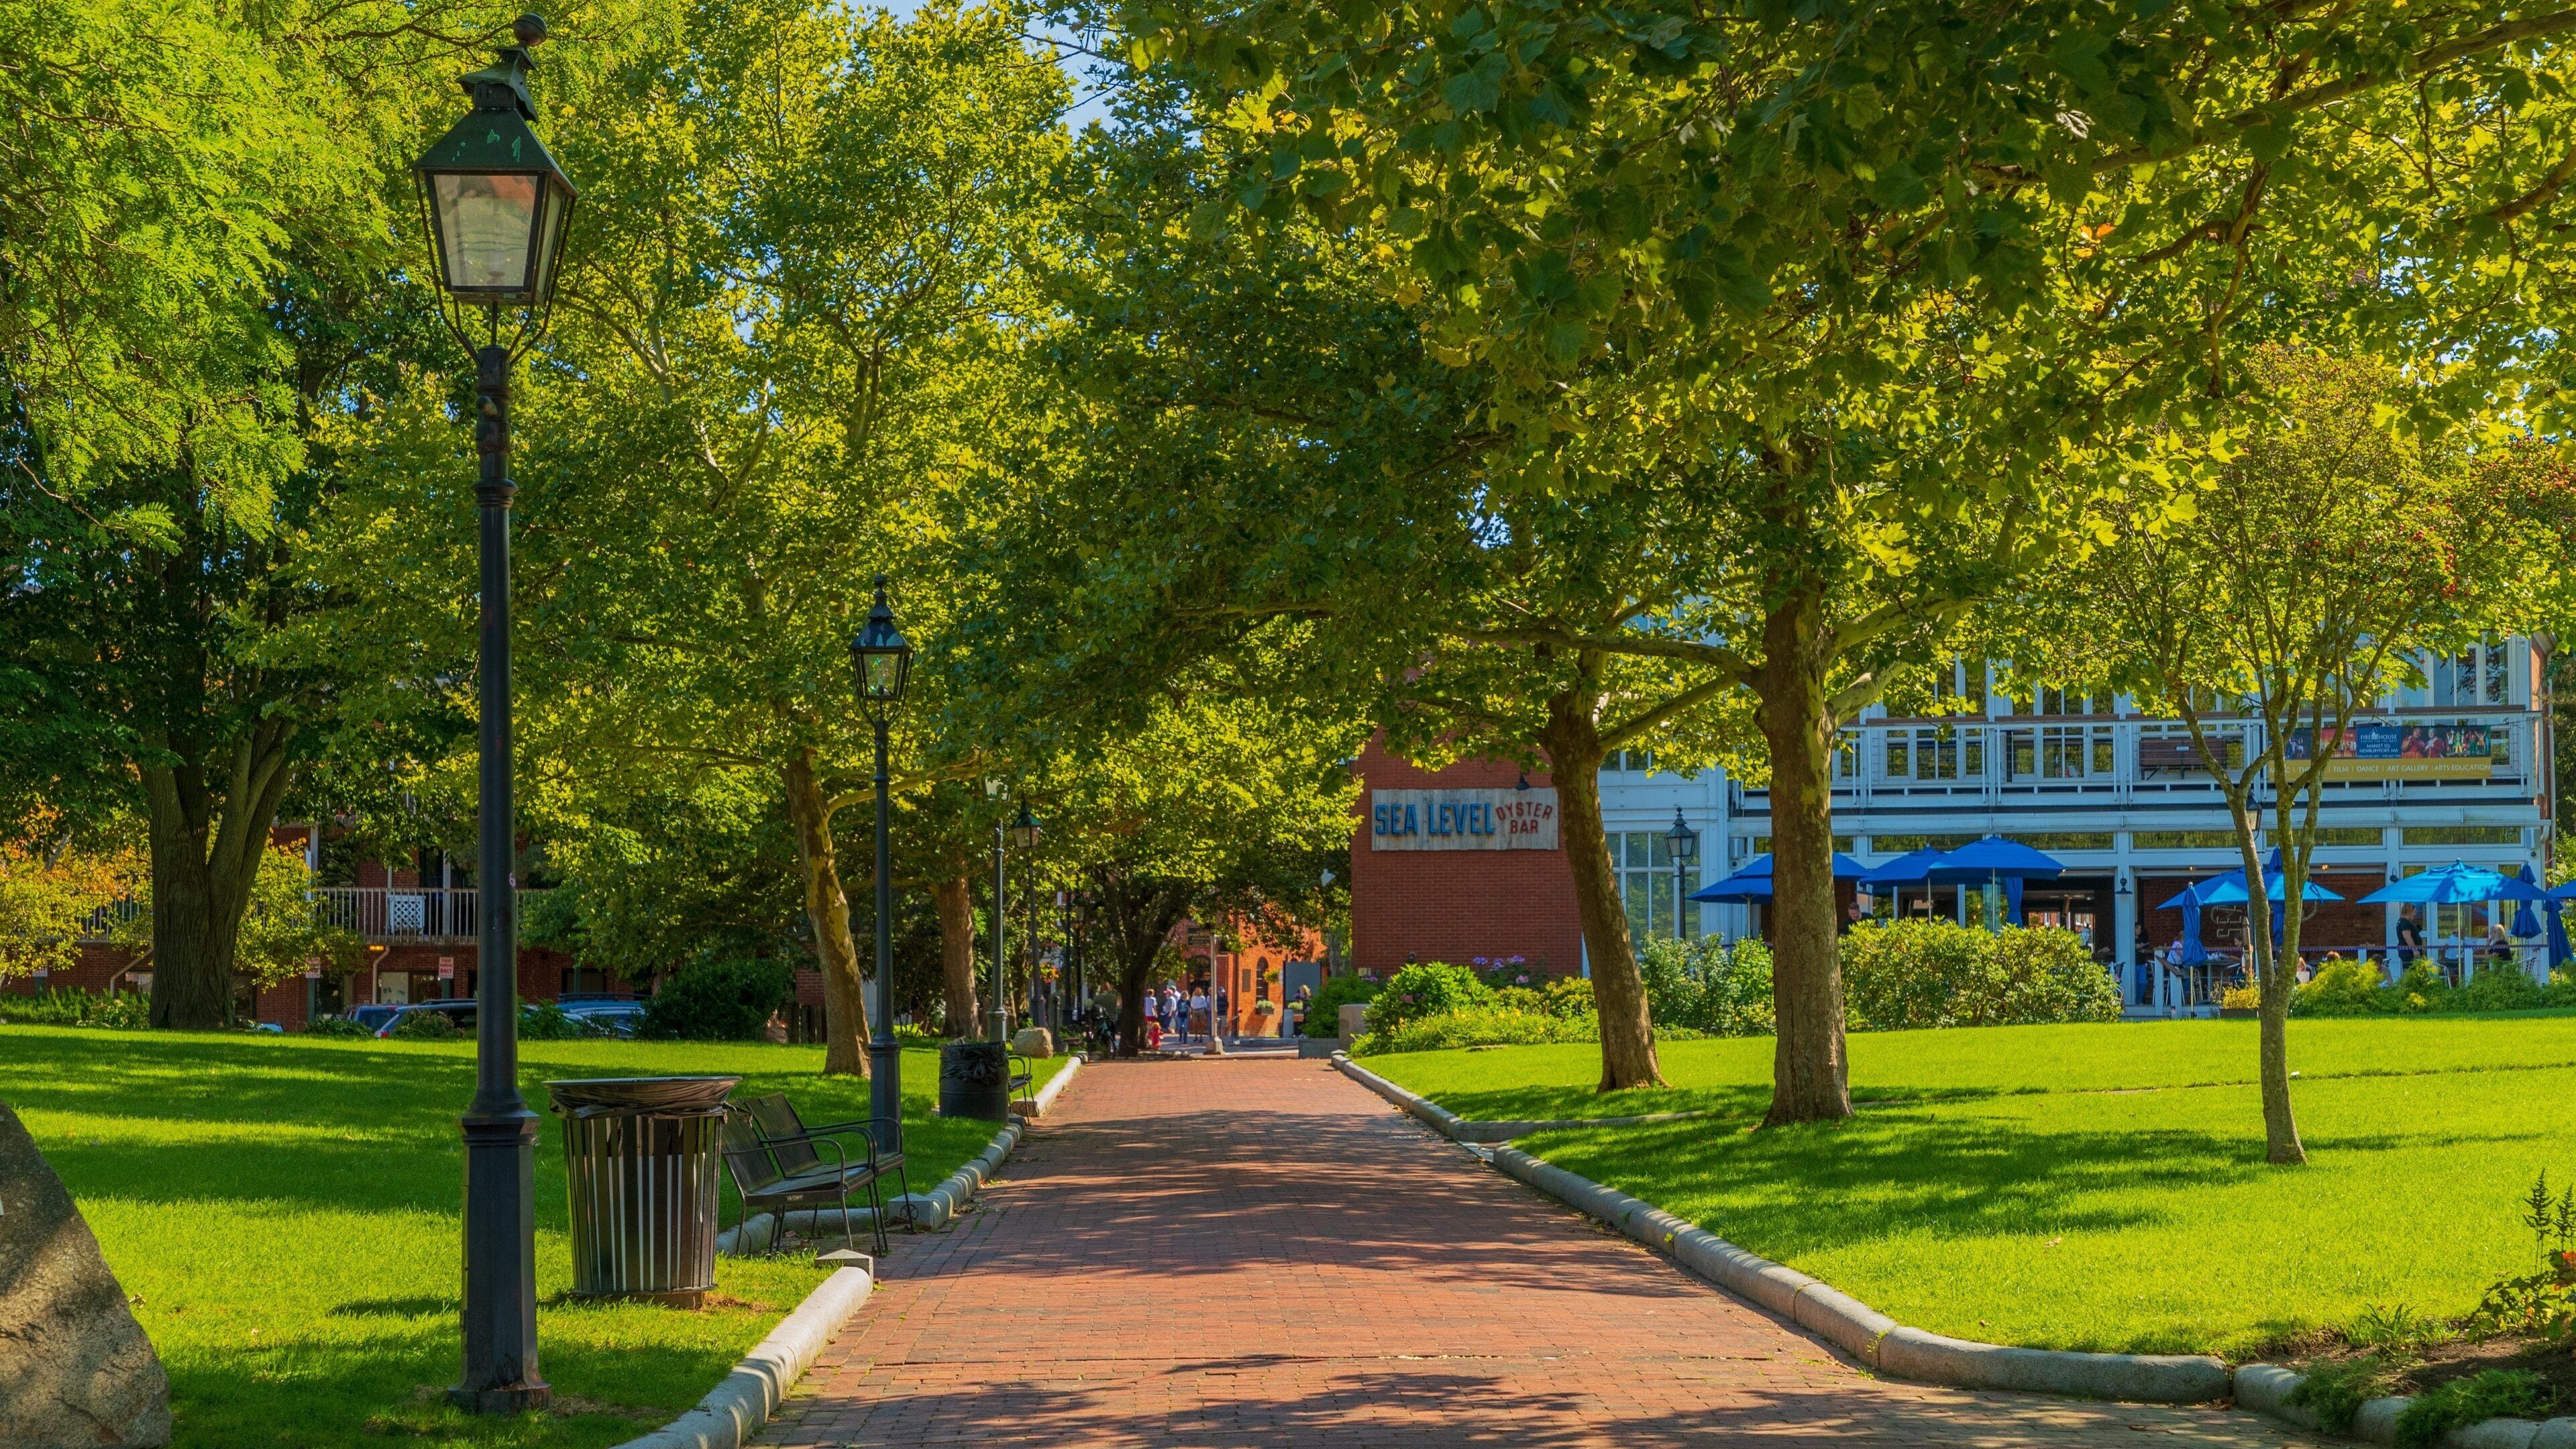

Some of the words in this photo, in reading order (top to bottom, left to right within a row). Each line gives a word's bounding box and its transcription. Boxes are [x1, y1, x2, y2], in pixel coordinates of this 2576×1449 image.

[2451, 763, 2491, 771] EDUCATION
[1375, 803, 1417, 835] SEA
[1428, 803, 1496, 835] LEVEL
[1495, 802, 1553, 820] OYSTER
[1510, 819, 1539, 834] BAR
